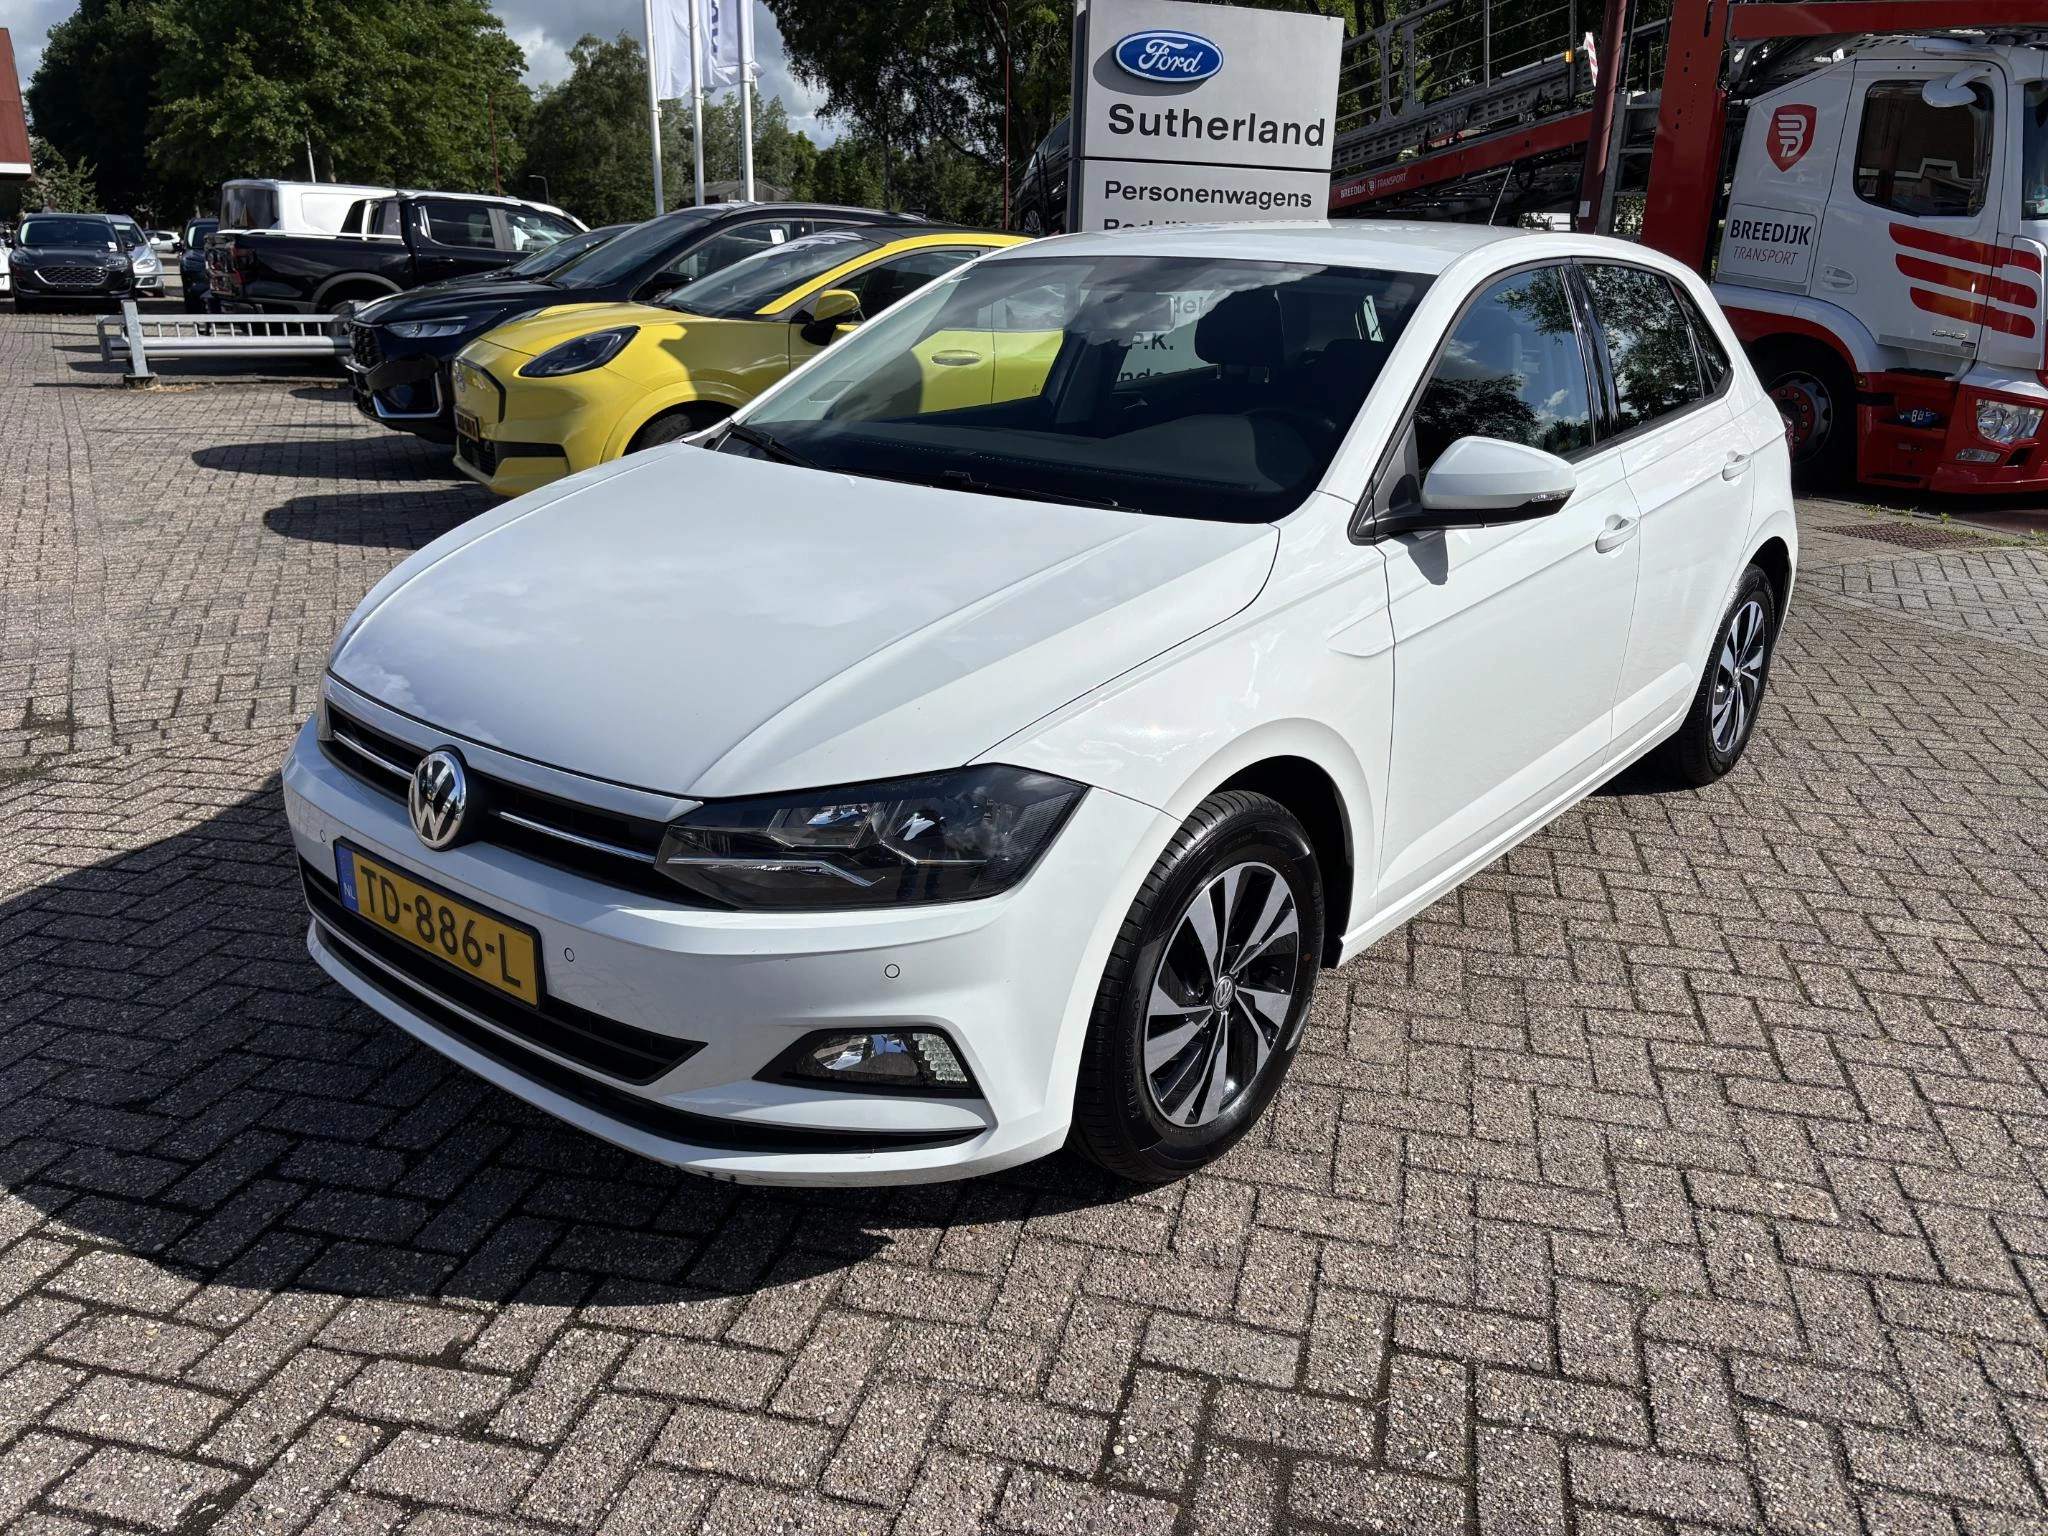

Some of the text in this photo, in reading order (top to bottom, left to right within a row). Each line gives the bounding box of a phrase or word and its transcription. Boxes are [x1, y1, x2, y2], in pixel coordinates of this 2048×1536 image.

[1138, 39, 1203, 74] Ford
[1108, 104, 1325, 147] Sutherland
[1104, 180, 1312, 211] Personenwagens
[1730, 219, 1812, 246] BREEDIJK
[1733, 246, 1799, 266] TRANSPORT
[343, 881, 356, 900] NL
[360, 865, 521, 988] TD-886-L
